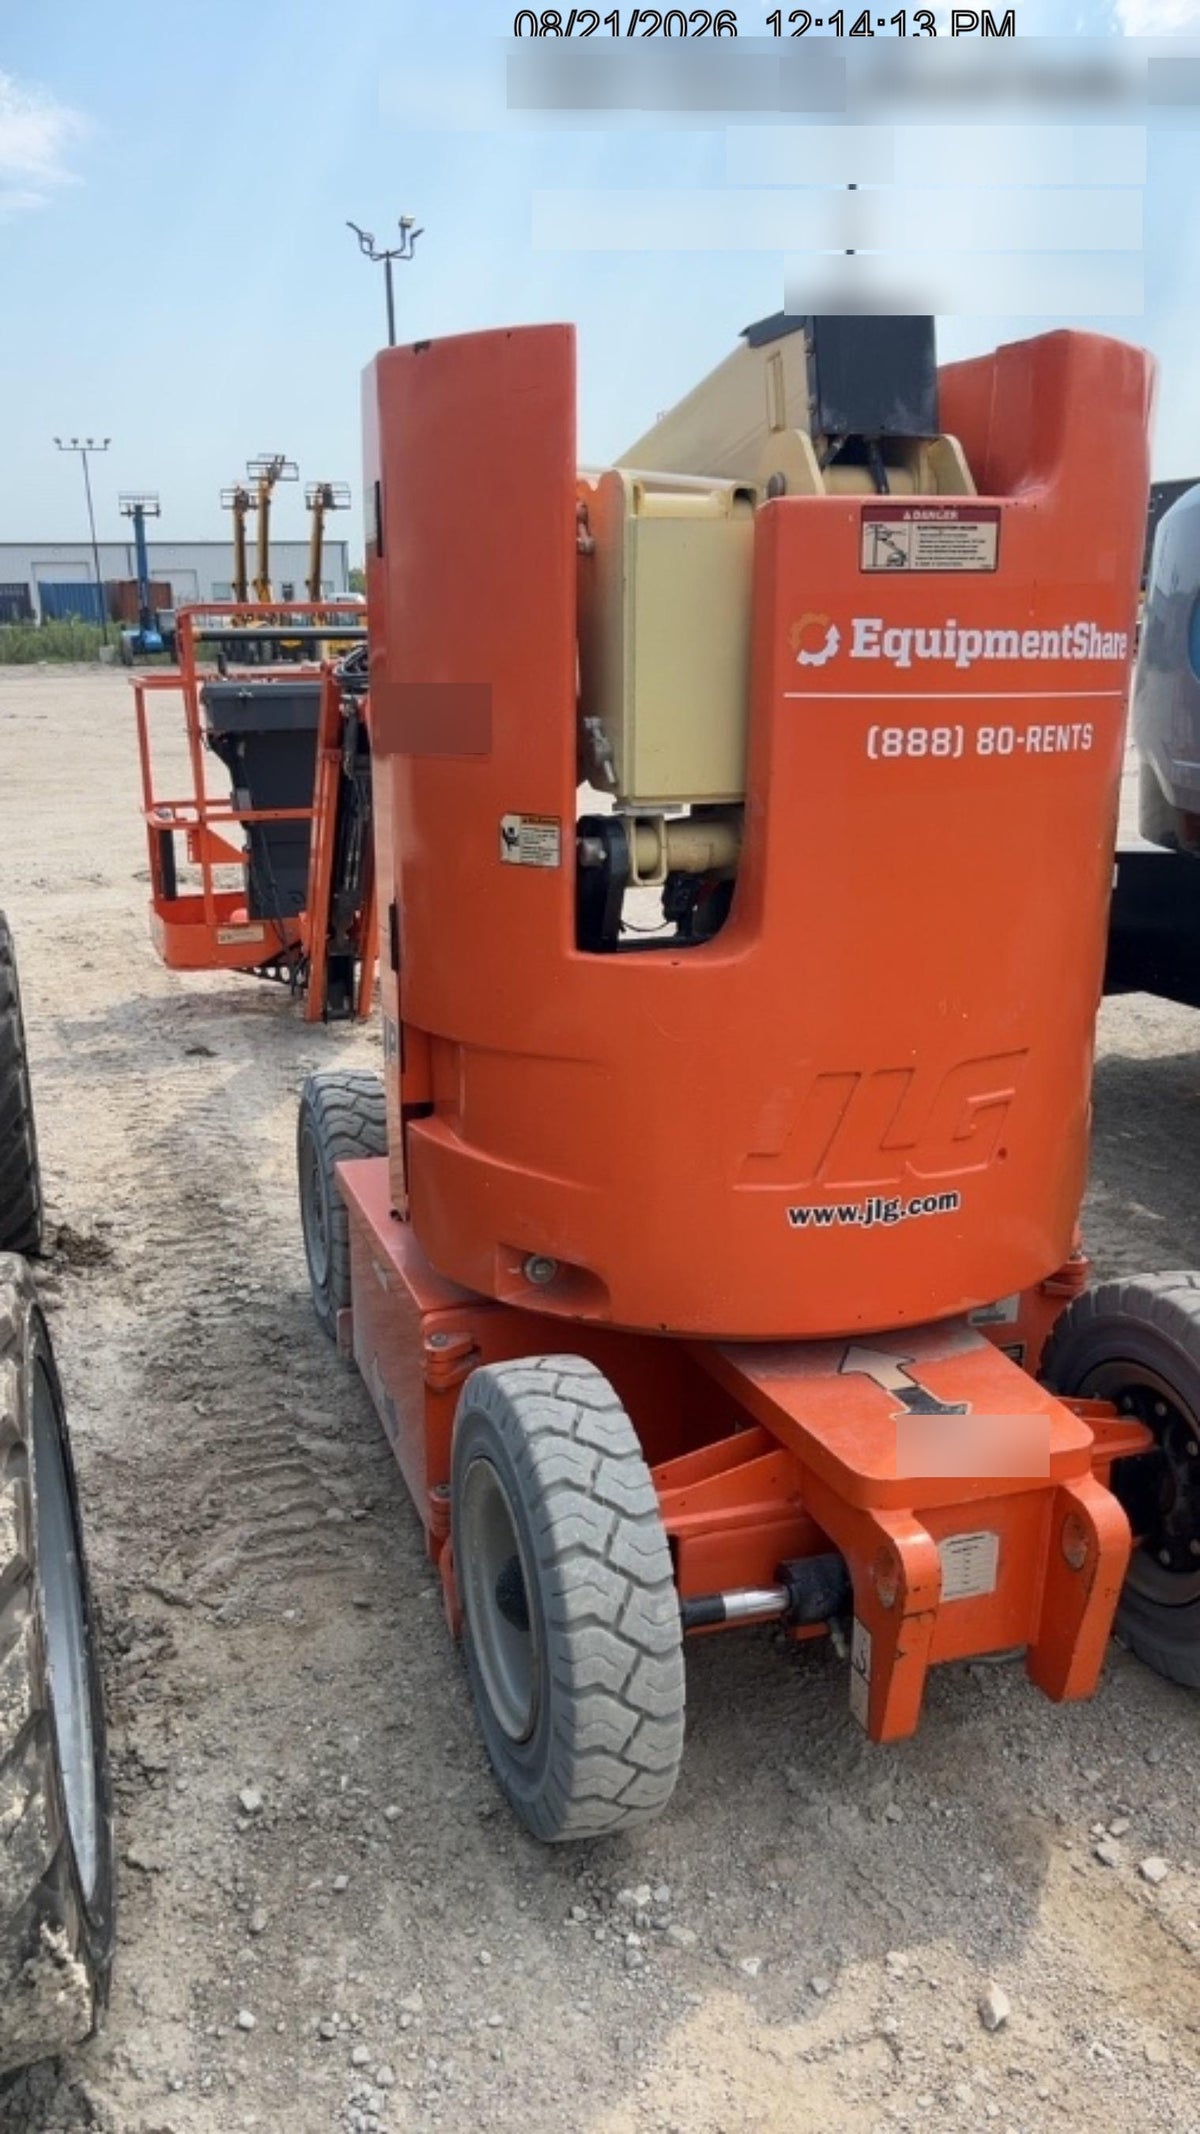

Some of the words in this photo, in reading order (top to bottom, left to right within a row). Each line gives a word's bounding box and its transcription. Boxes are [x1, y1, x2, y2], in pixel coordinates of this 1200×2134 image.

[850, 618, 1127, 667] EquipmentShare
[866, 725, 964, 759] (888)
[976, 723, 1093, 755] 80-RENTS
[732, 1047, 1029, 1191] JLG
[788, 1190, 960, 1227] www.jlg.com
